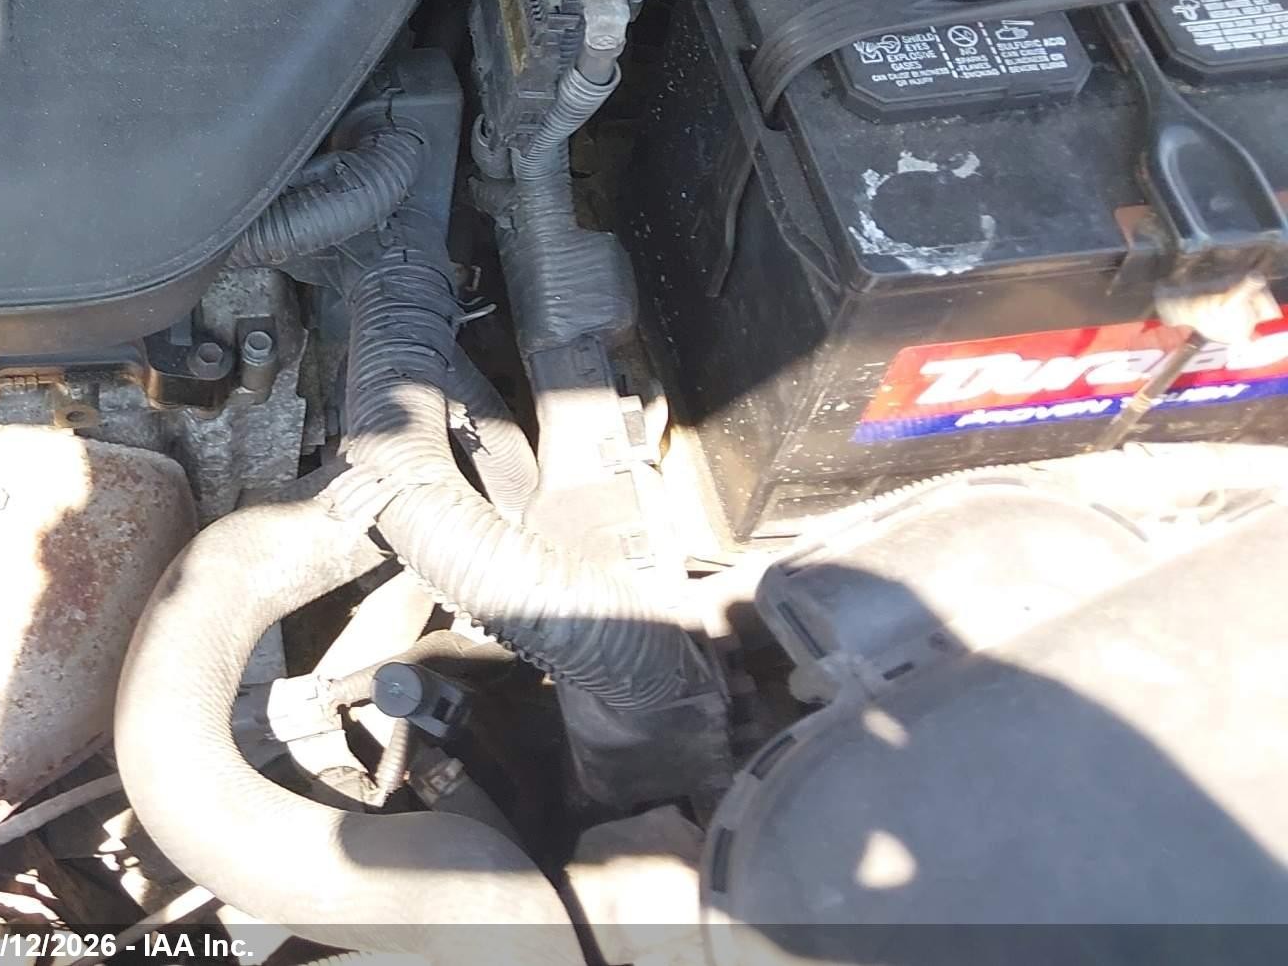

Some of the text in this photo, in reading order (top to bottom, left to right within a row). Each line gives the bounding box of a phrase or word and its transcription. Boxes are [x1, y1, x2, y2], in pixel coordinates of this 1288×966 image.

[901, 32, 936, 44] SHIELD
[905, 42, 930, 52] EYES
[959, 47, 978, 56] NO
[886, 49, 938, 63] EXPLOSIVE
[890, 60, 923, 72] GASES
